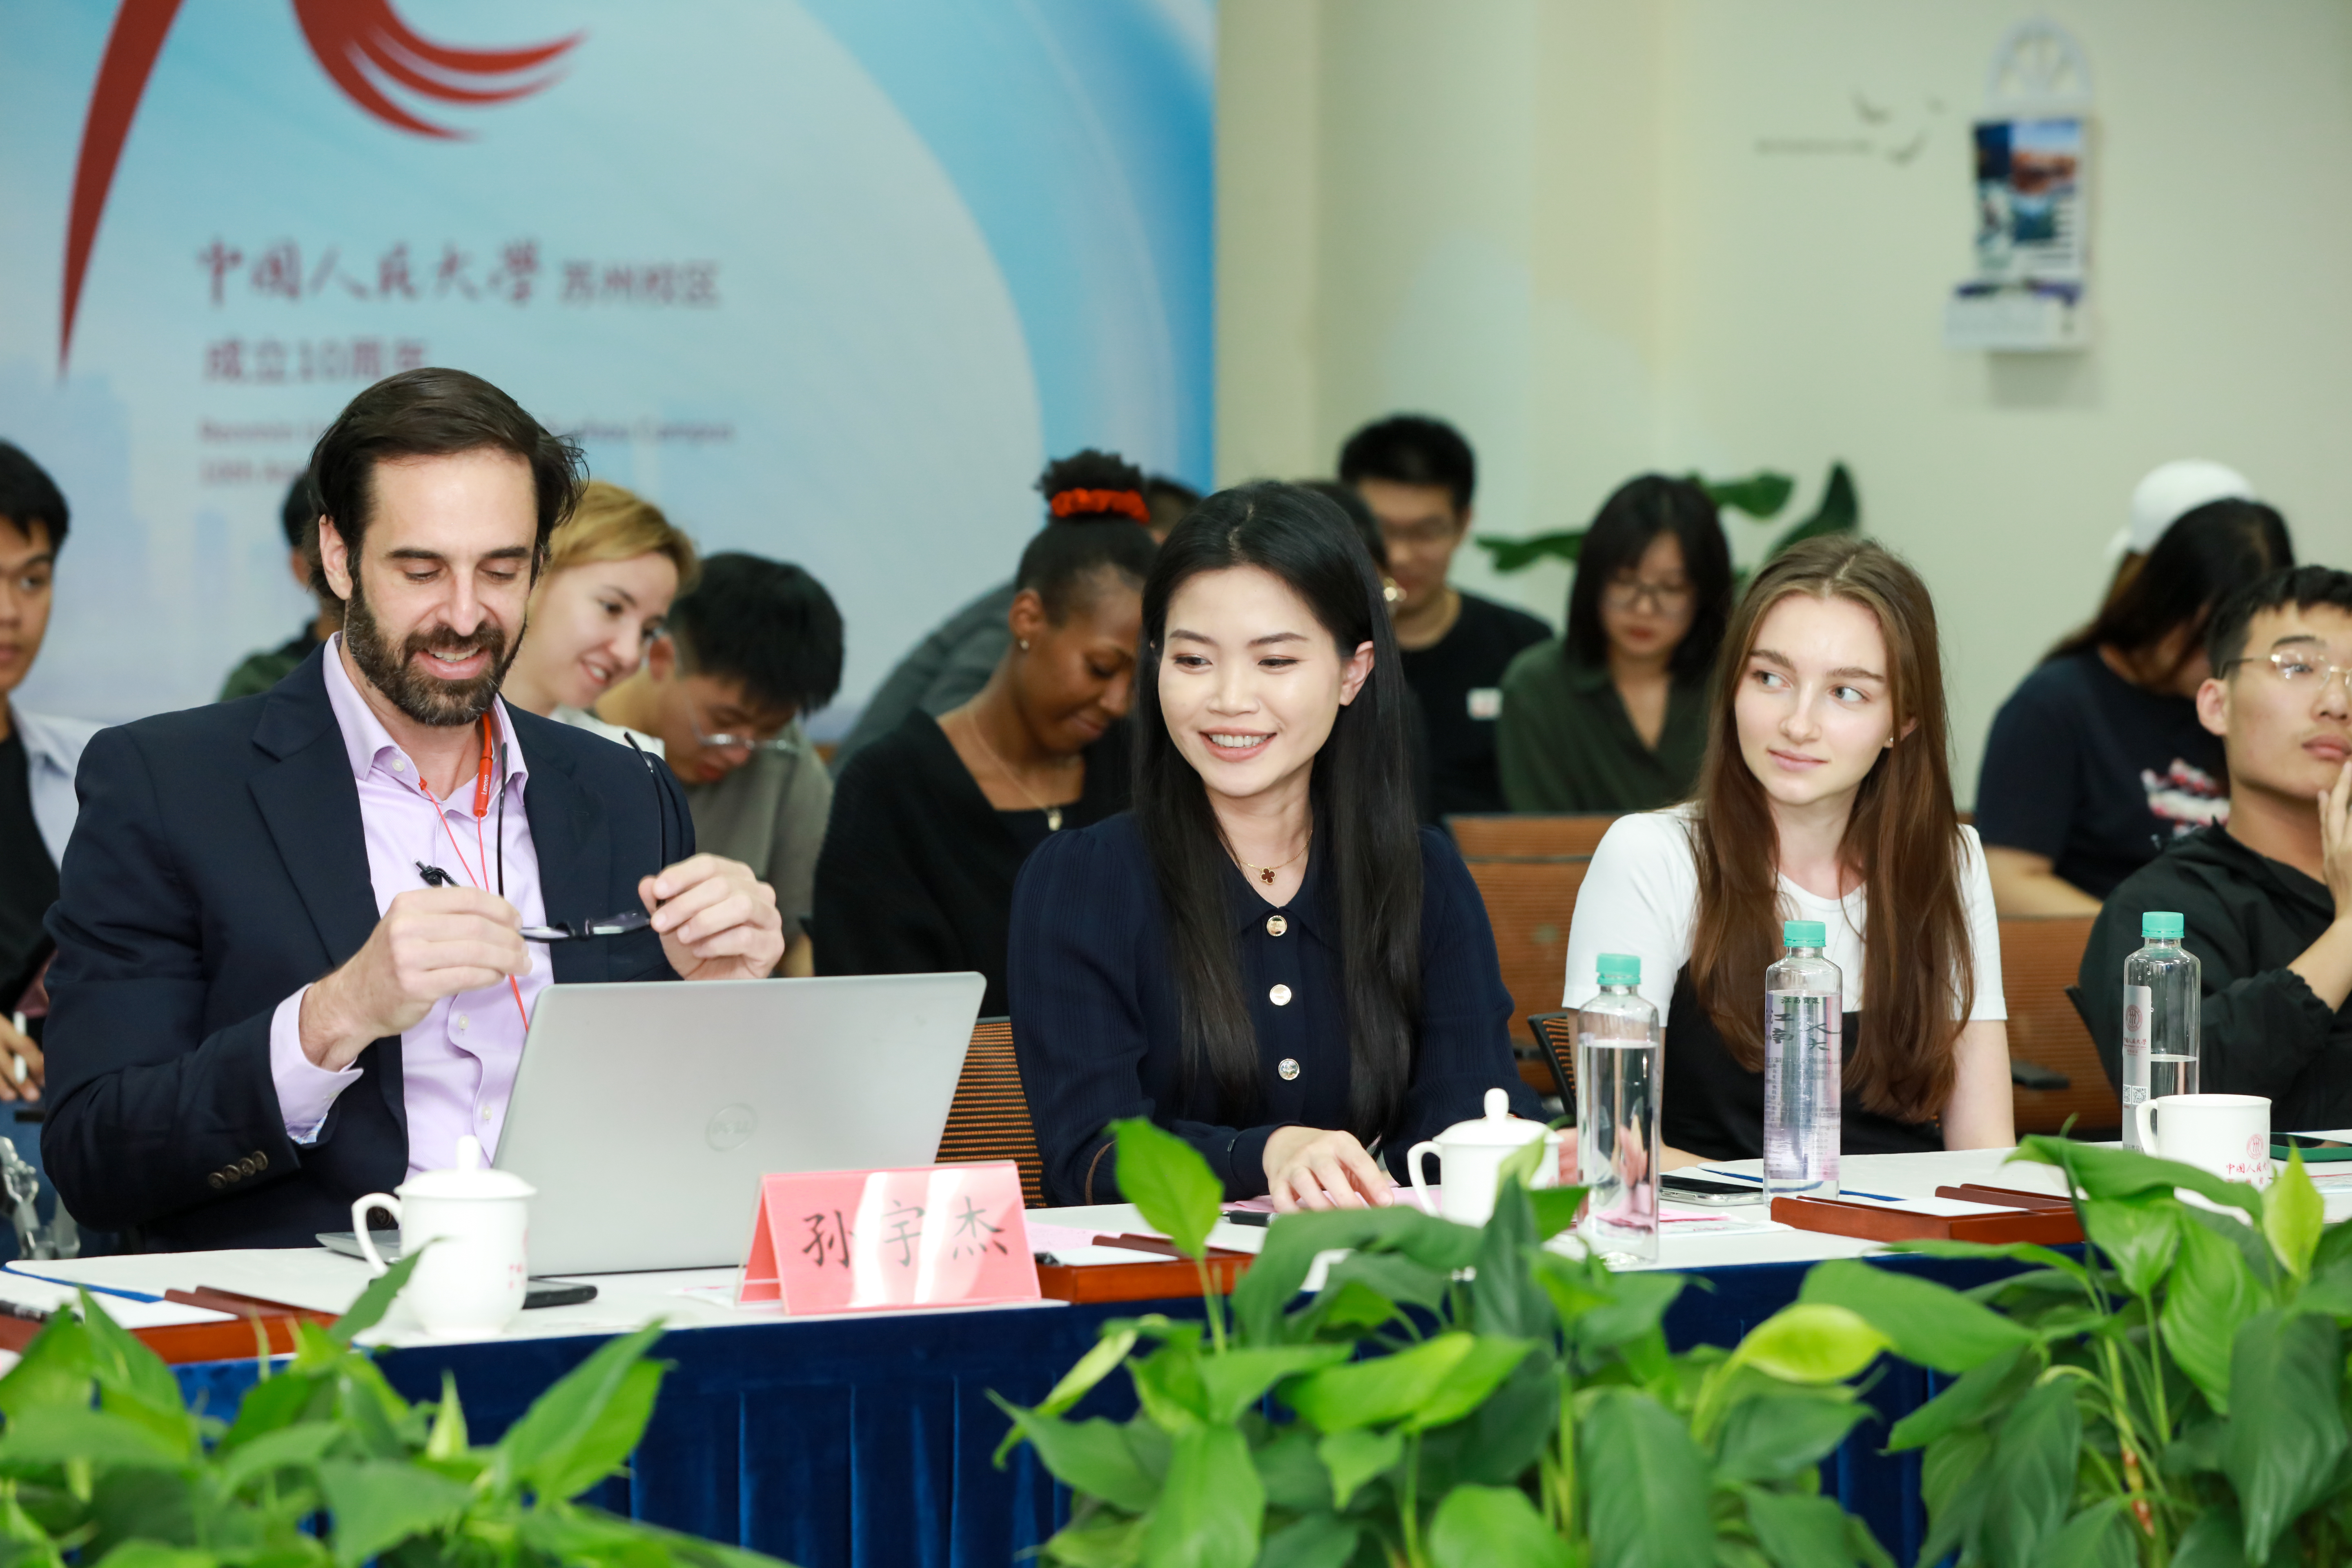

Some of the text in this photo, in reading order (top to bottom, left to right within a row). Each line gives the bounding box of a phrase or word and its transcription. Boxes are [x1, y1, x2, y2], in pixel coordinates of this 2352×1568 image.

[481, 774, 489, 795] Lenovo
[803, 1196, 1009, 1267] 孙宇杰
